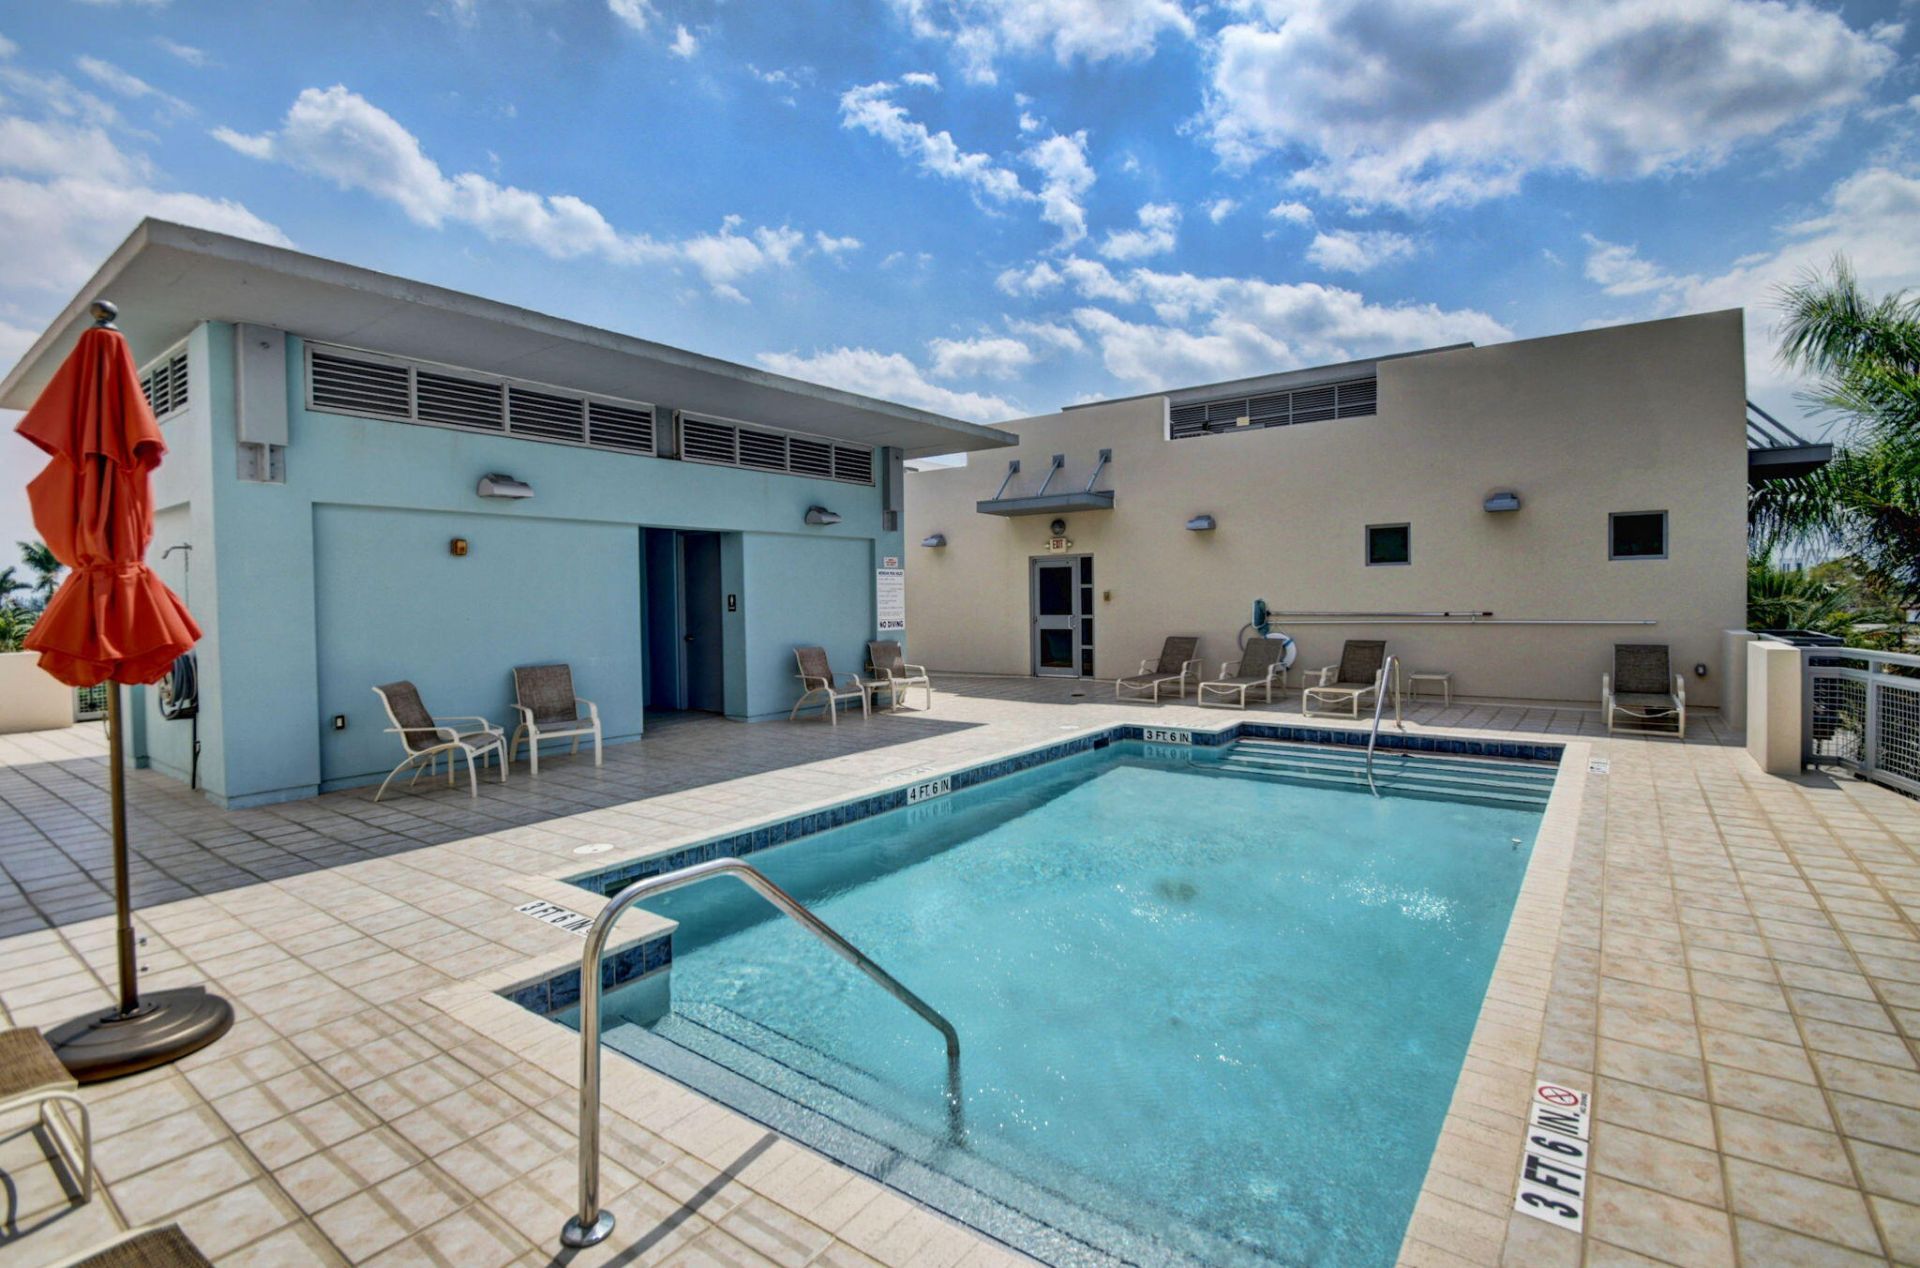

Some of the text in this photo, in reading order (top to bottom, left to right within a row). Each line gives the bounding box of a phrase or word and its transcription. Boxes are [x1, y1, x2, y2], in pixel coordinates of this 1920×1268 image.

[887, 620, 904, 628] DIVING
[1146, 730, 1153, 740] 3
[1170, 732, 1177, 742] 6
[910, 787, 917, 800] 4
[932, 782, 938, 794] 6
[520, 902, 546, 912] 3
[550, 913, 576, 923] 6
[1521, 1107, 1583, 1219] 3 FT 6 IN.
